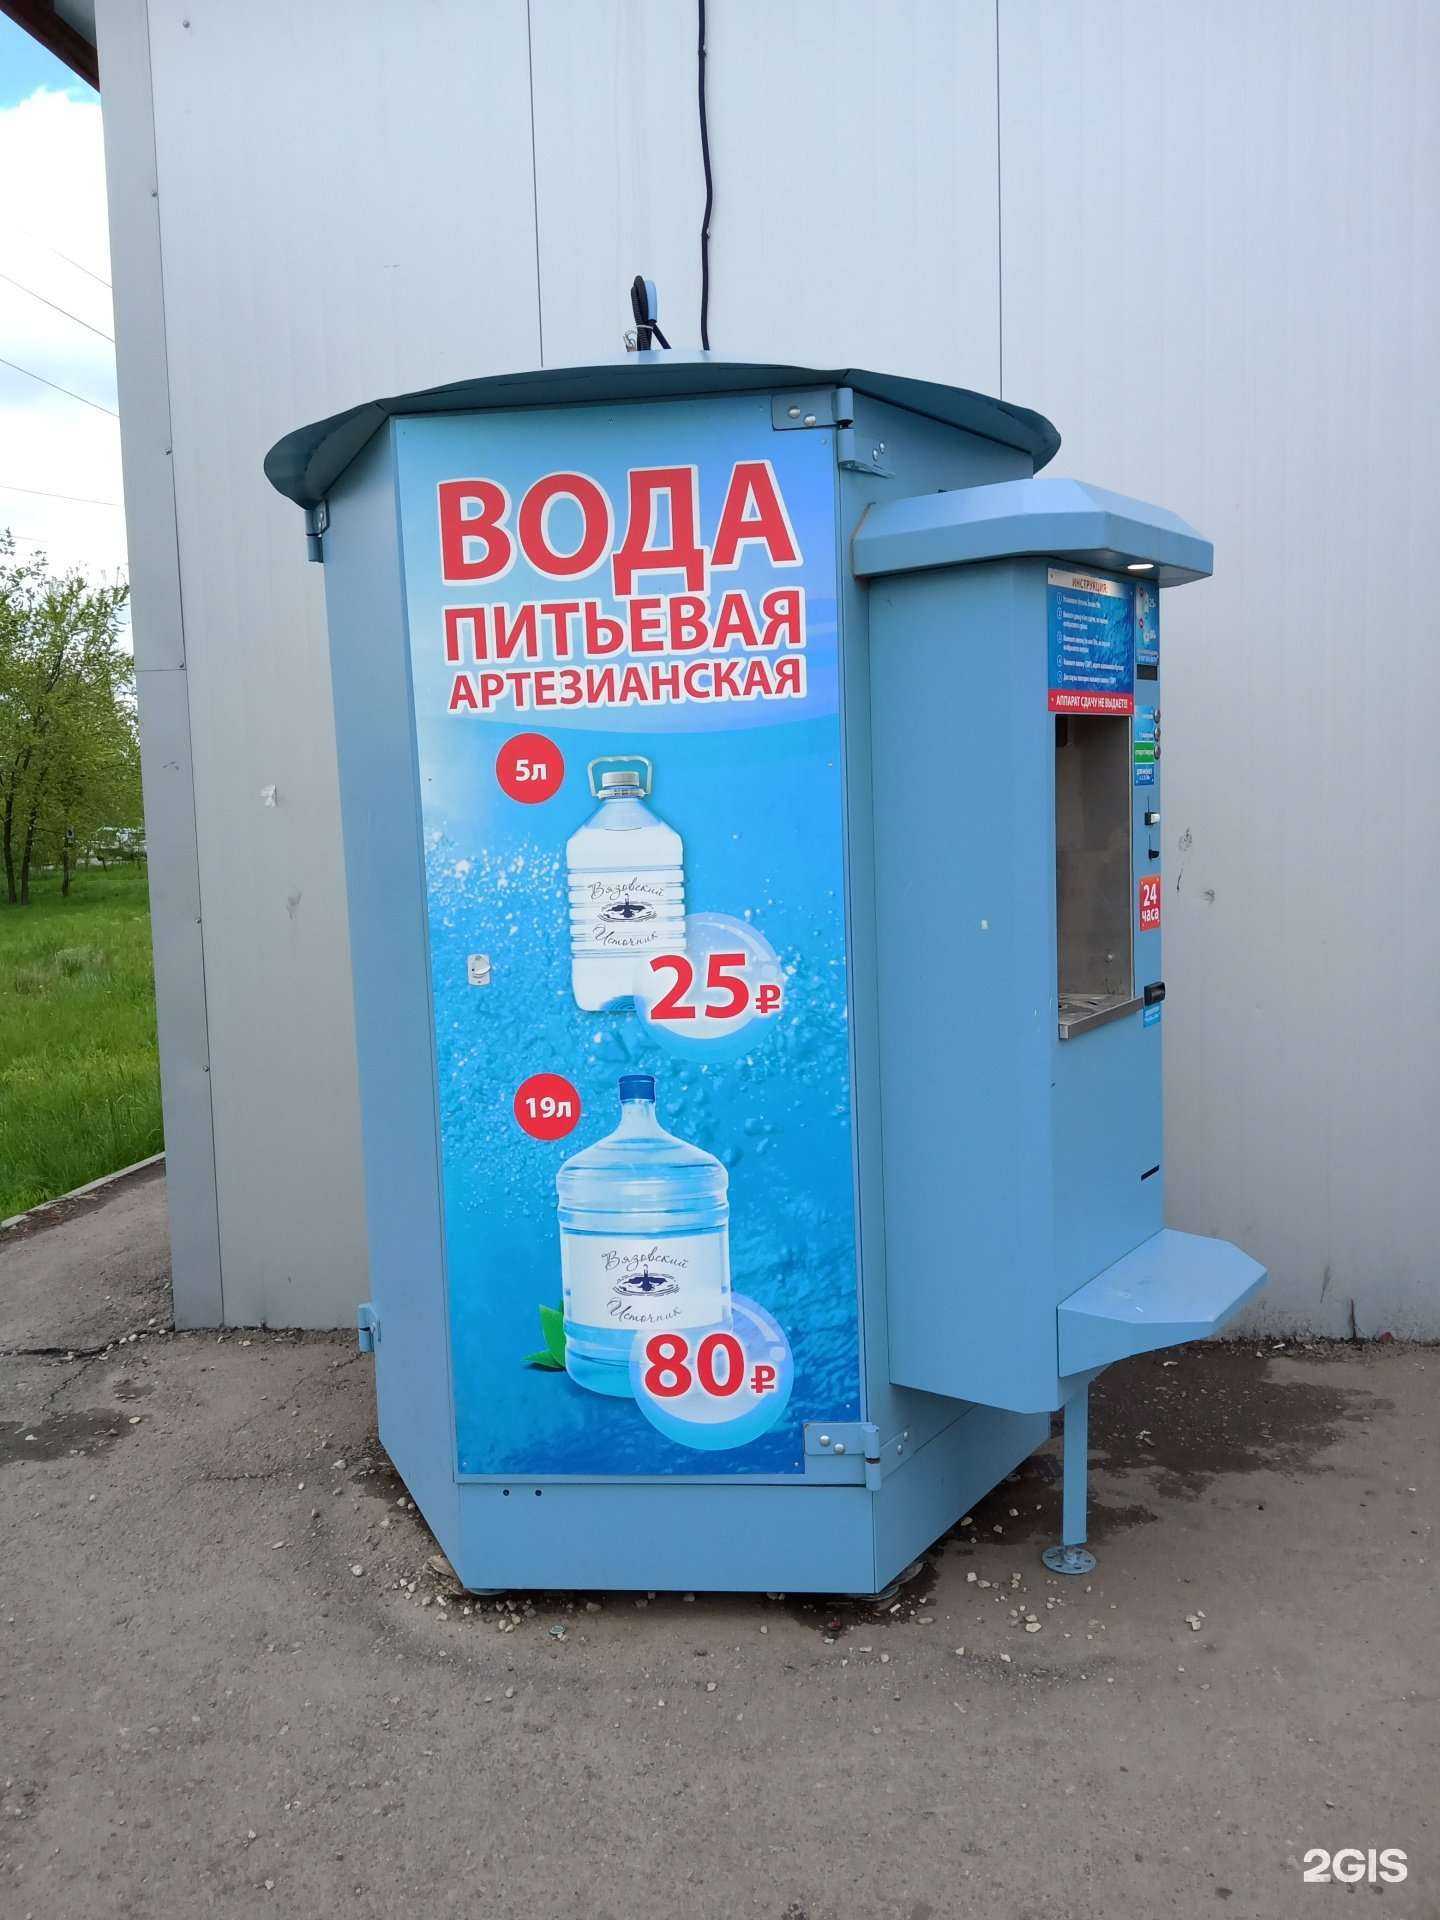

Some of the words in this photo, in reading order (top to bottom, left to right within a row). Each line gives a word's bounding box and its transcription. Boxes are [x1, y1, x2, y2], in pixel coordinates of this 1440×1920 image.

[438, 462, 797, 596] ВОДА
[444, 590, 800, 661] ПИТЬЕВАЯ
[449, 658, 801, 710] АРТЕЗИАНСКАЯ
[1056, 695, 1080, 706] АППАРАТ
[515, 759, 547, 781] 5л
[588, 877, 664, 900] Вязовский
[1143, 883, 1157, 906] 24
[1141, 907, 1159, 923] часа
[592, 926, 659, 946] Источник
[525, 1097, 572, 1119] 19л
[601, 1246, 689, 1270] Вязовский
[606, 1298, 682, 1323] Источник
